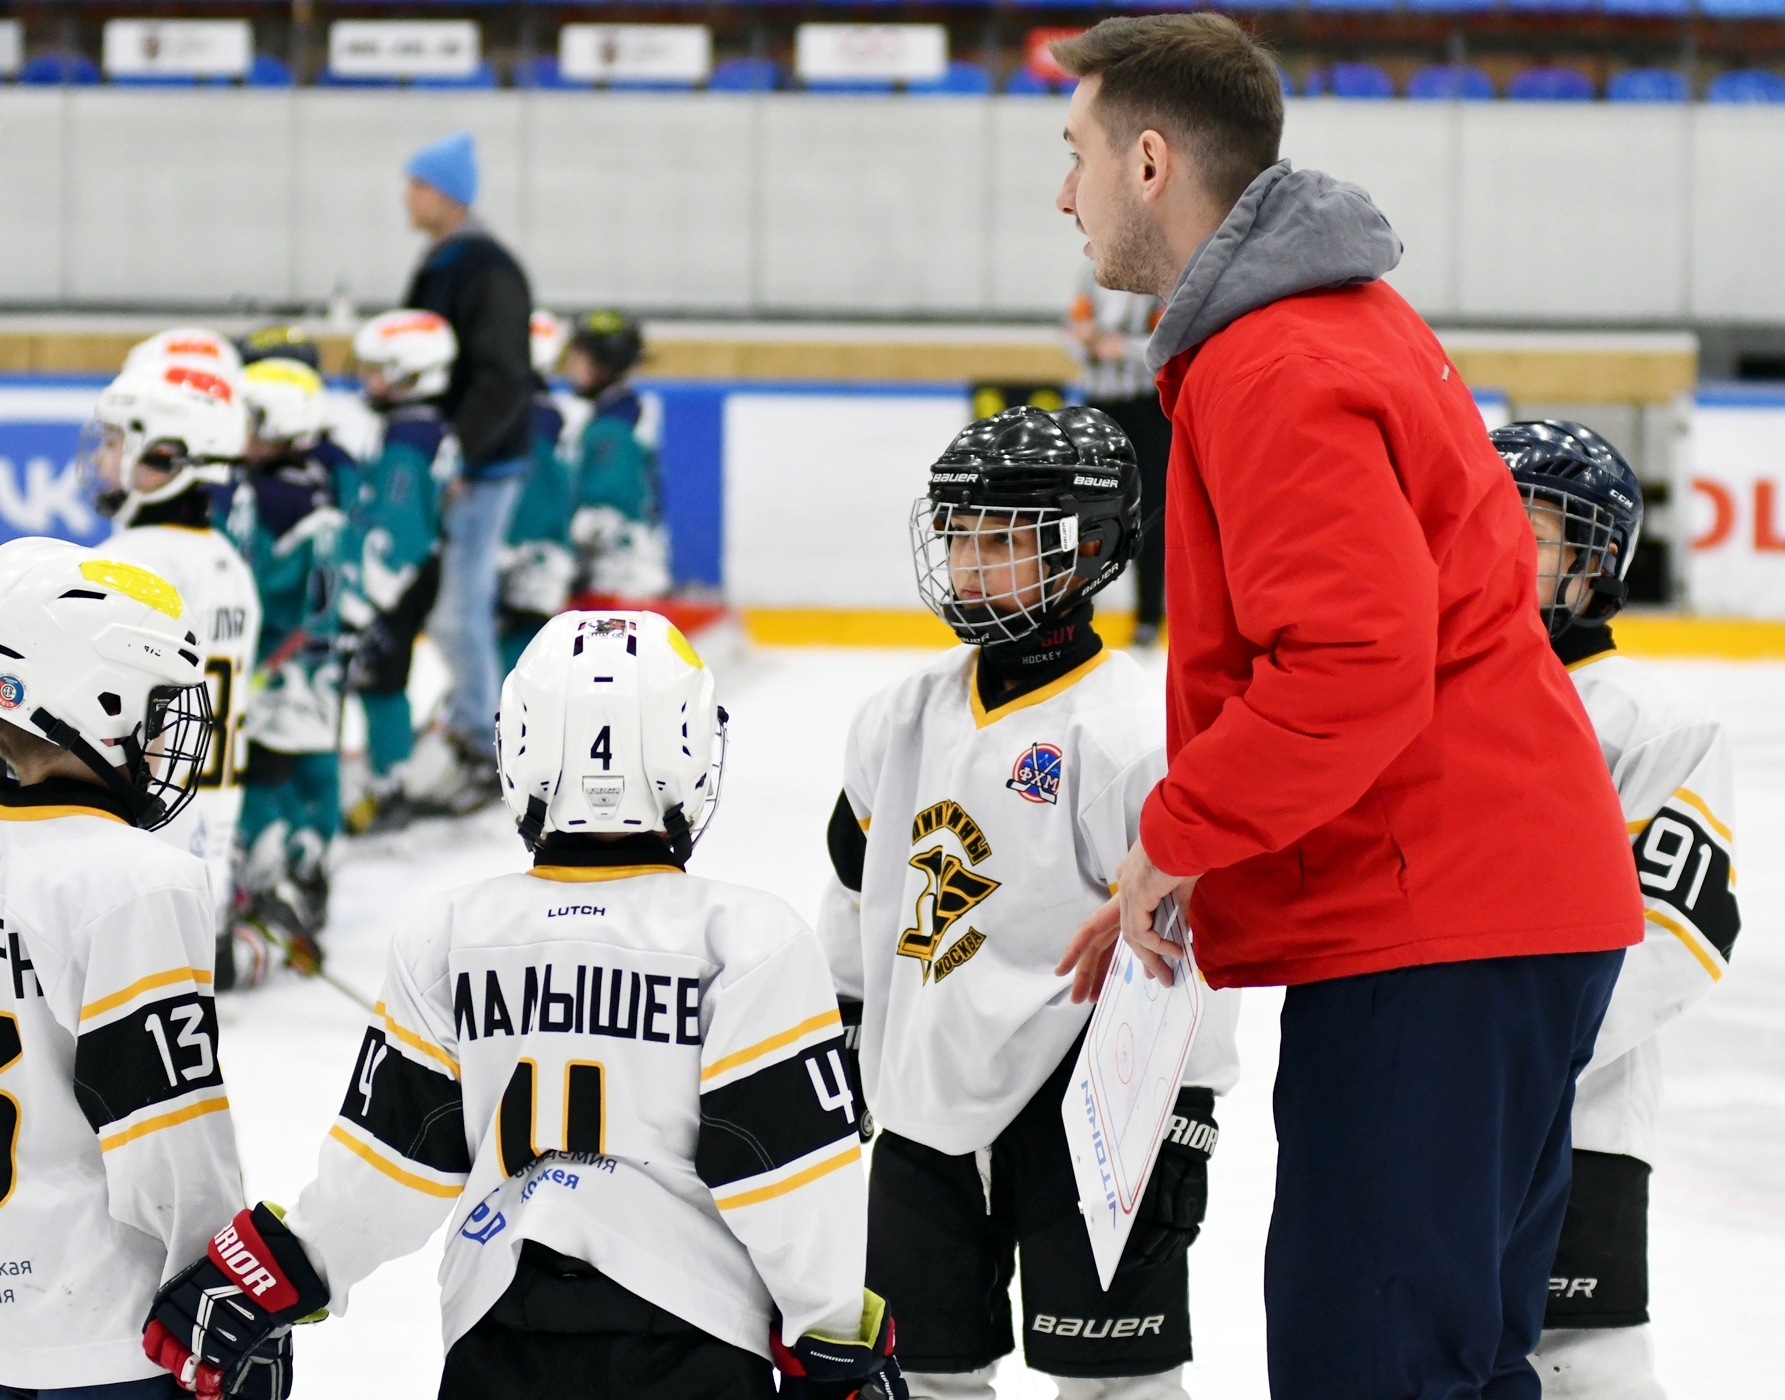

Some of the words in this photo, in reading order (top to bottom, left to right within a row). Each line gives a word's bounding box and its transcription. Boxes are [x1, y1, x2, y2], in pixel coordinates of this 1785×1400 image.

[1073, 475, 1119, 489] BAUER
[1609, 488, 1634, 509] CCM
[1081, 562, 1119, 597] BAUER
[1022, 650, 1062, 665] HOCKEY
[590, 725, 612, 771] 4
[1018, 766, 1060, 794] ФХМ
[1640, 815, 1711, 910] 91
[547, 905, 606, 918] LUTCH
[934, 926, 986, 983] МОСКВА
[144, 1002, 214, 1088] 13
[358, 1038, 388, 1117] 4
[805, 1048, 856, 1125] 4
[1031, 1314, 1165, 1339] BAUER
